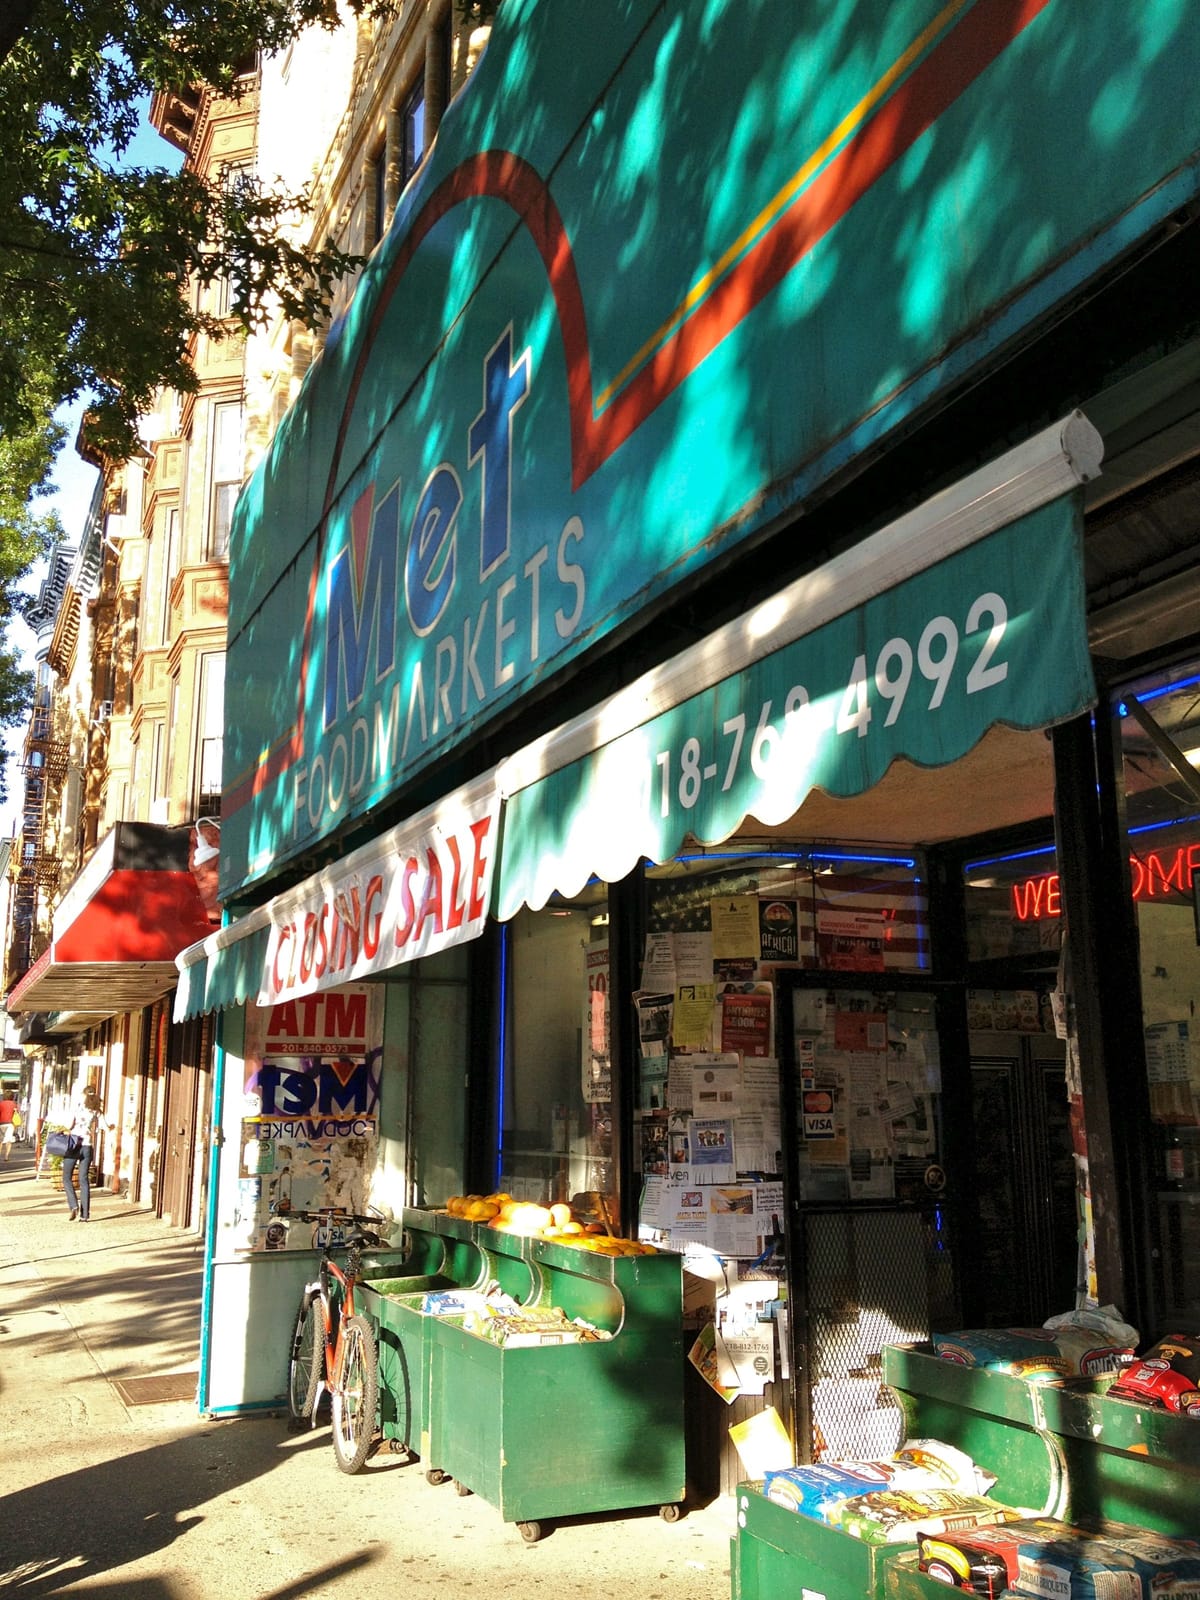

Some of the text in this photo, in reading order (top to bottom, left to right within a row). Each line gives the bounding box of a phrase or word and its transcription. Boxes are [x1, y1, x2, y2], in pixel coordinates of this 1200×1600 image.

[323, 319, 532, 734] Met
[272, 815, 492, 994] CLOSING SALE
[267, 993, 368, 1039] ATM
[808, 1119, 833, 1131] VISA
[321, 1230, 345, 1241] VSA
